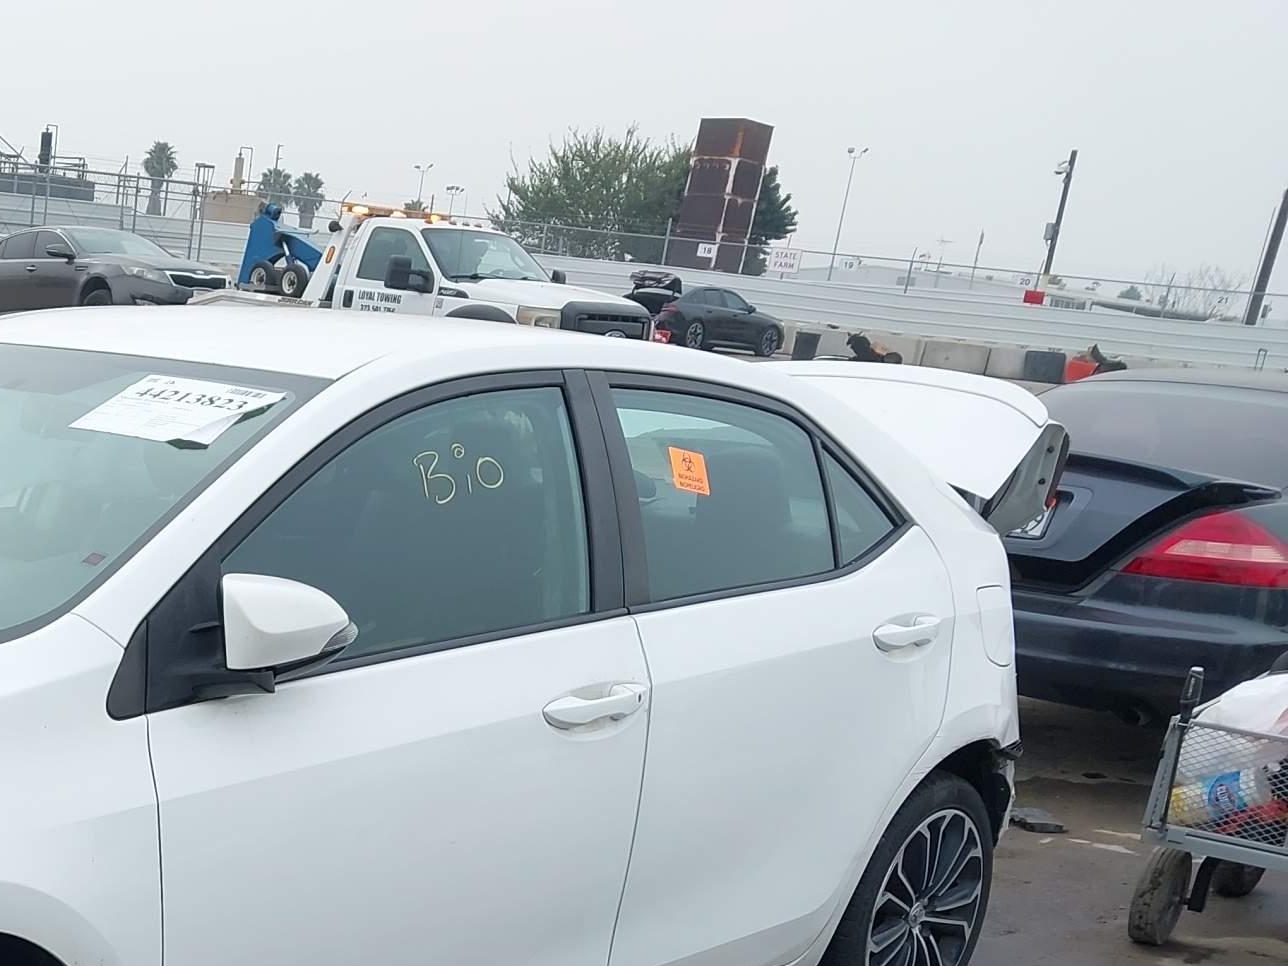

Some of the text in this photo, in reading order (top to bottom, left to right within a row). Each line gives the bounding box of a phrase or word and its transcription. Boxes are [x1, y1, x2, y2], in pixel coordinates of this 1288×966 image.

[702, 247, 712, 255] 18
[775, 251, 797, 259] STATE
[774, 260, 794, 269] FARM
[1019, 278, 1031, 286] 20
[358, 289, 402, 304] LOYAL TOWING
[1217, 296, 1229, 304] 21
[136, 387, 249, 410] 44213823
